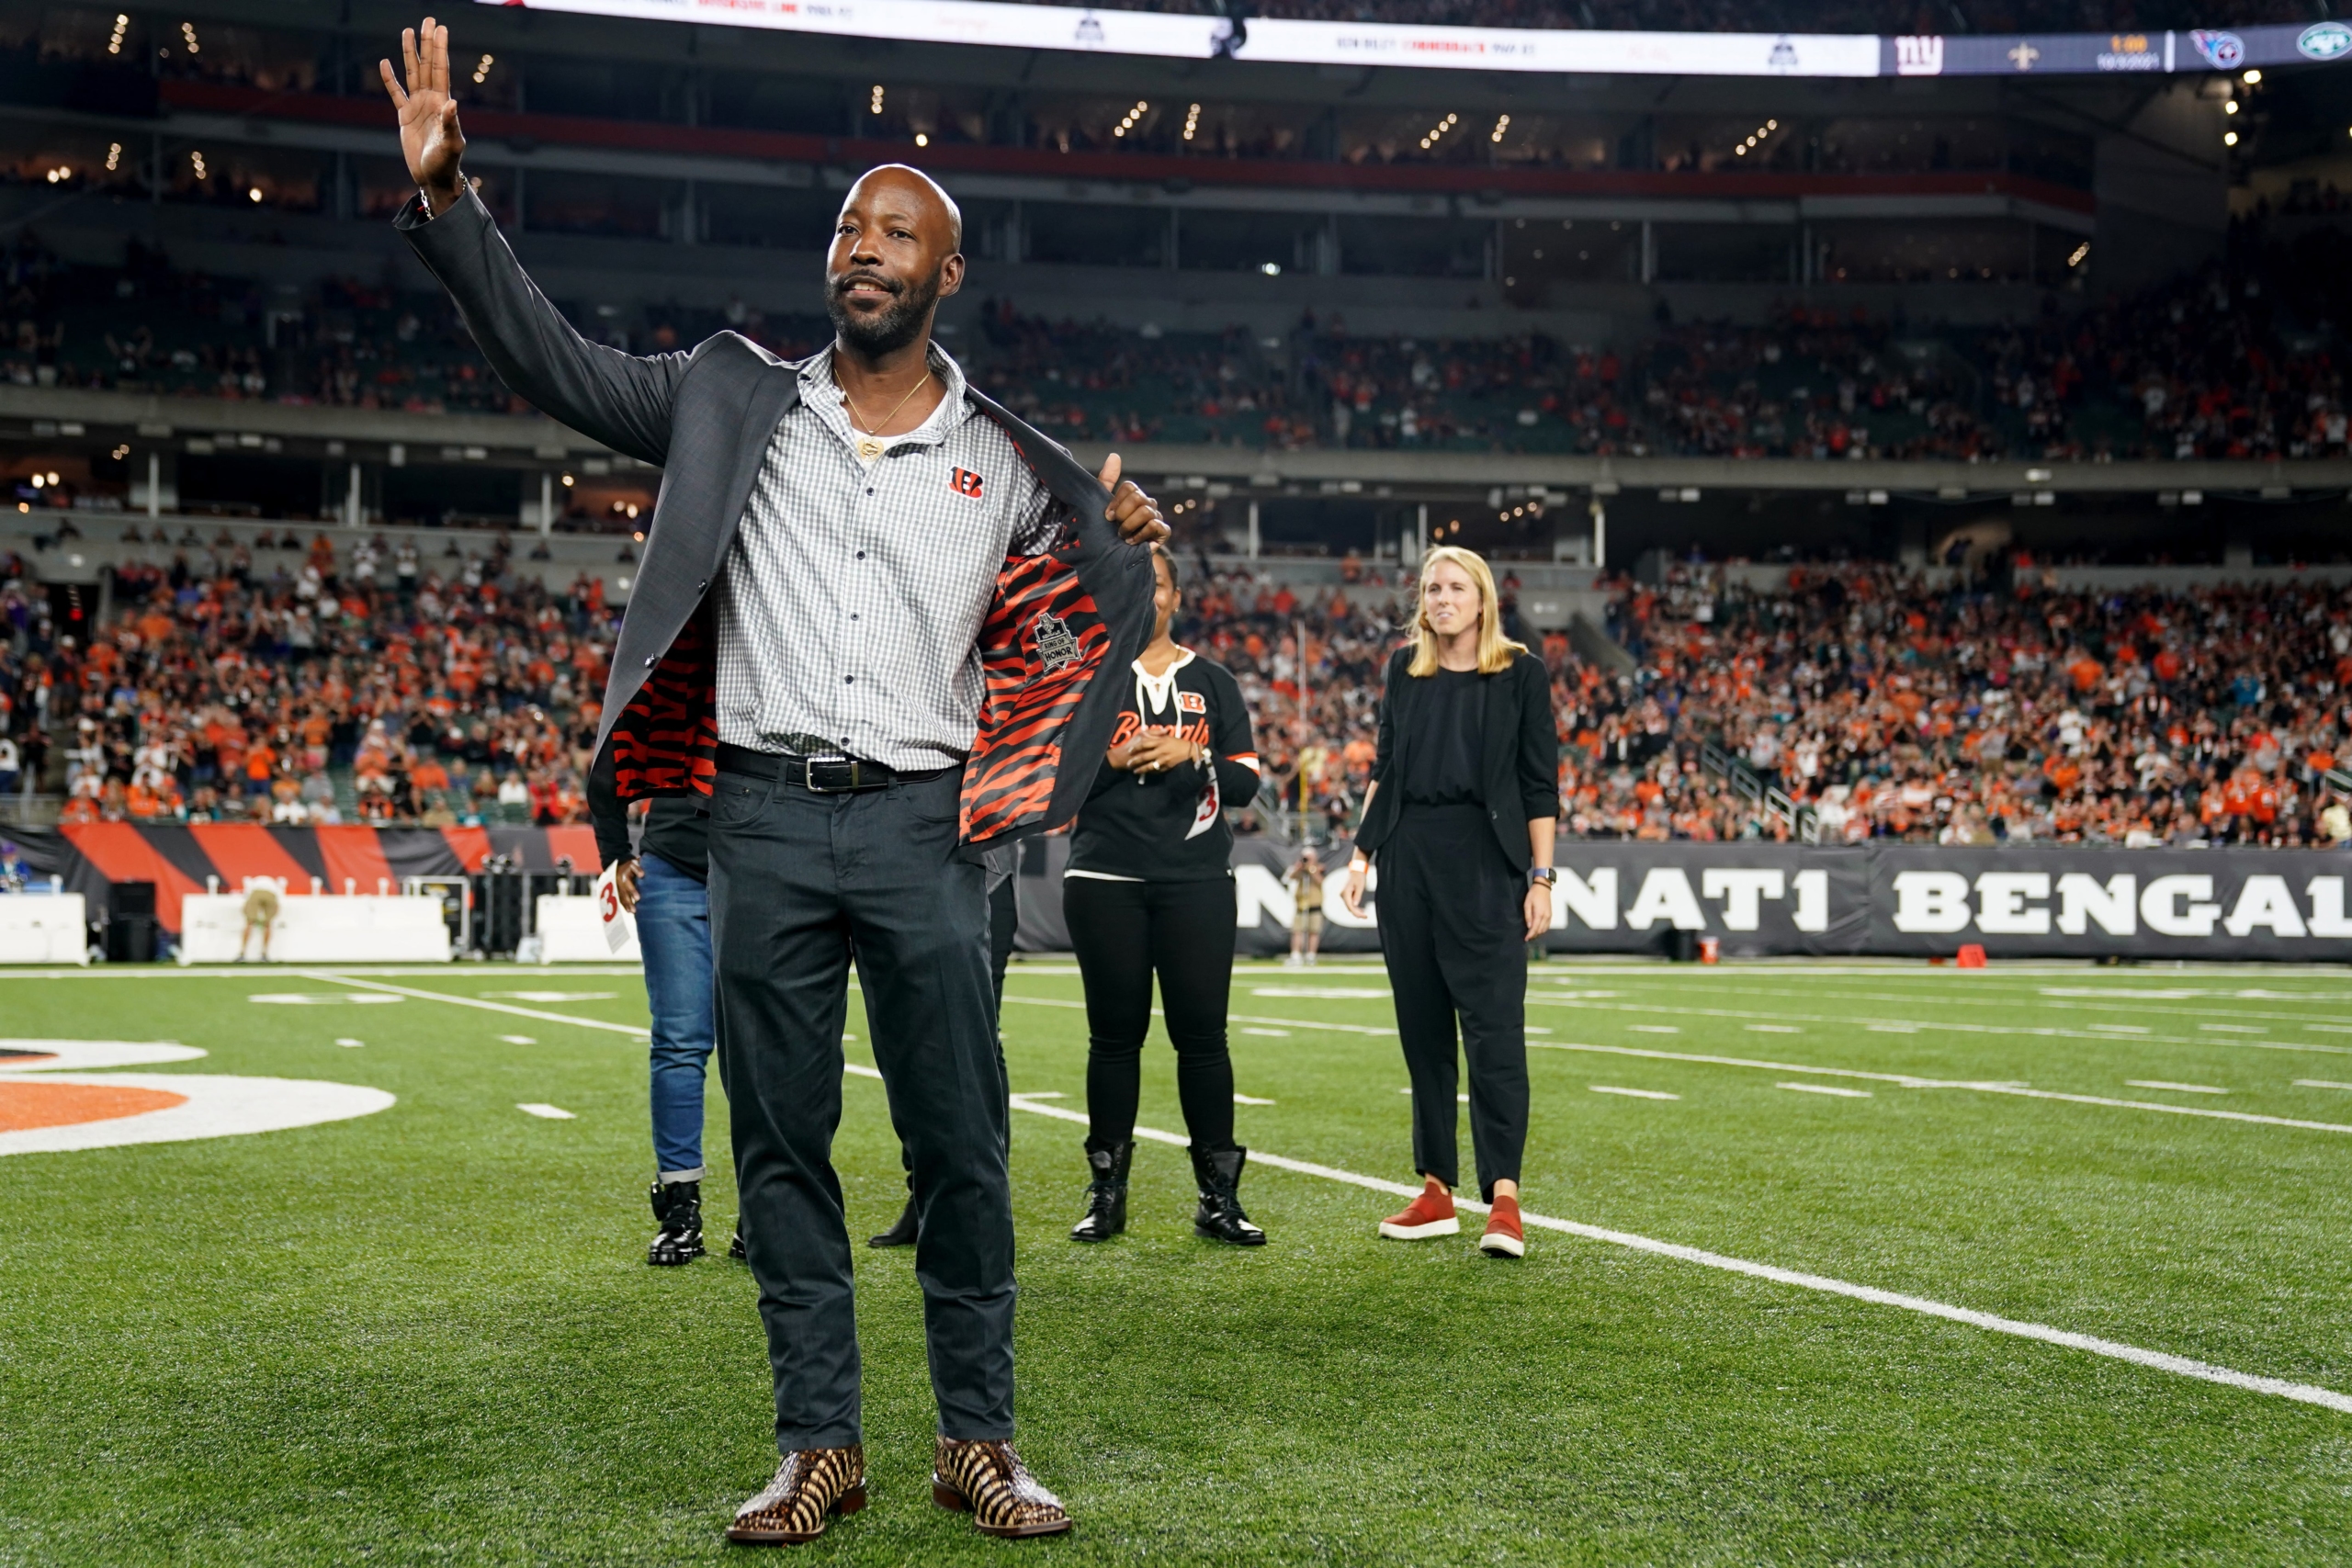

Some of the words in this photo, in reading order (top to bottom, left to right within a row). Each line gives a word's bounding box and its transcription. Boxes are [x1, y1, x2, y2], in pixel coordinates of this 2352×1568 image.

[947, 465, 984, 500] B
[1045, 640, 1057, 649] RING
[1045, 647, 1072, 661] HONOR
[600, 881, 618, 923] 3
